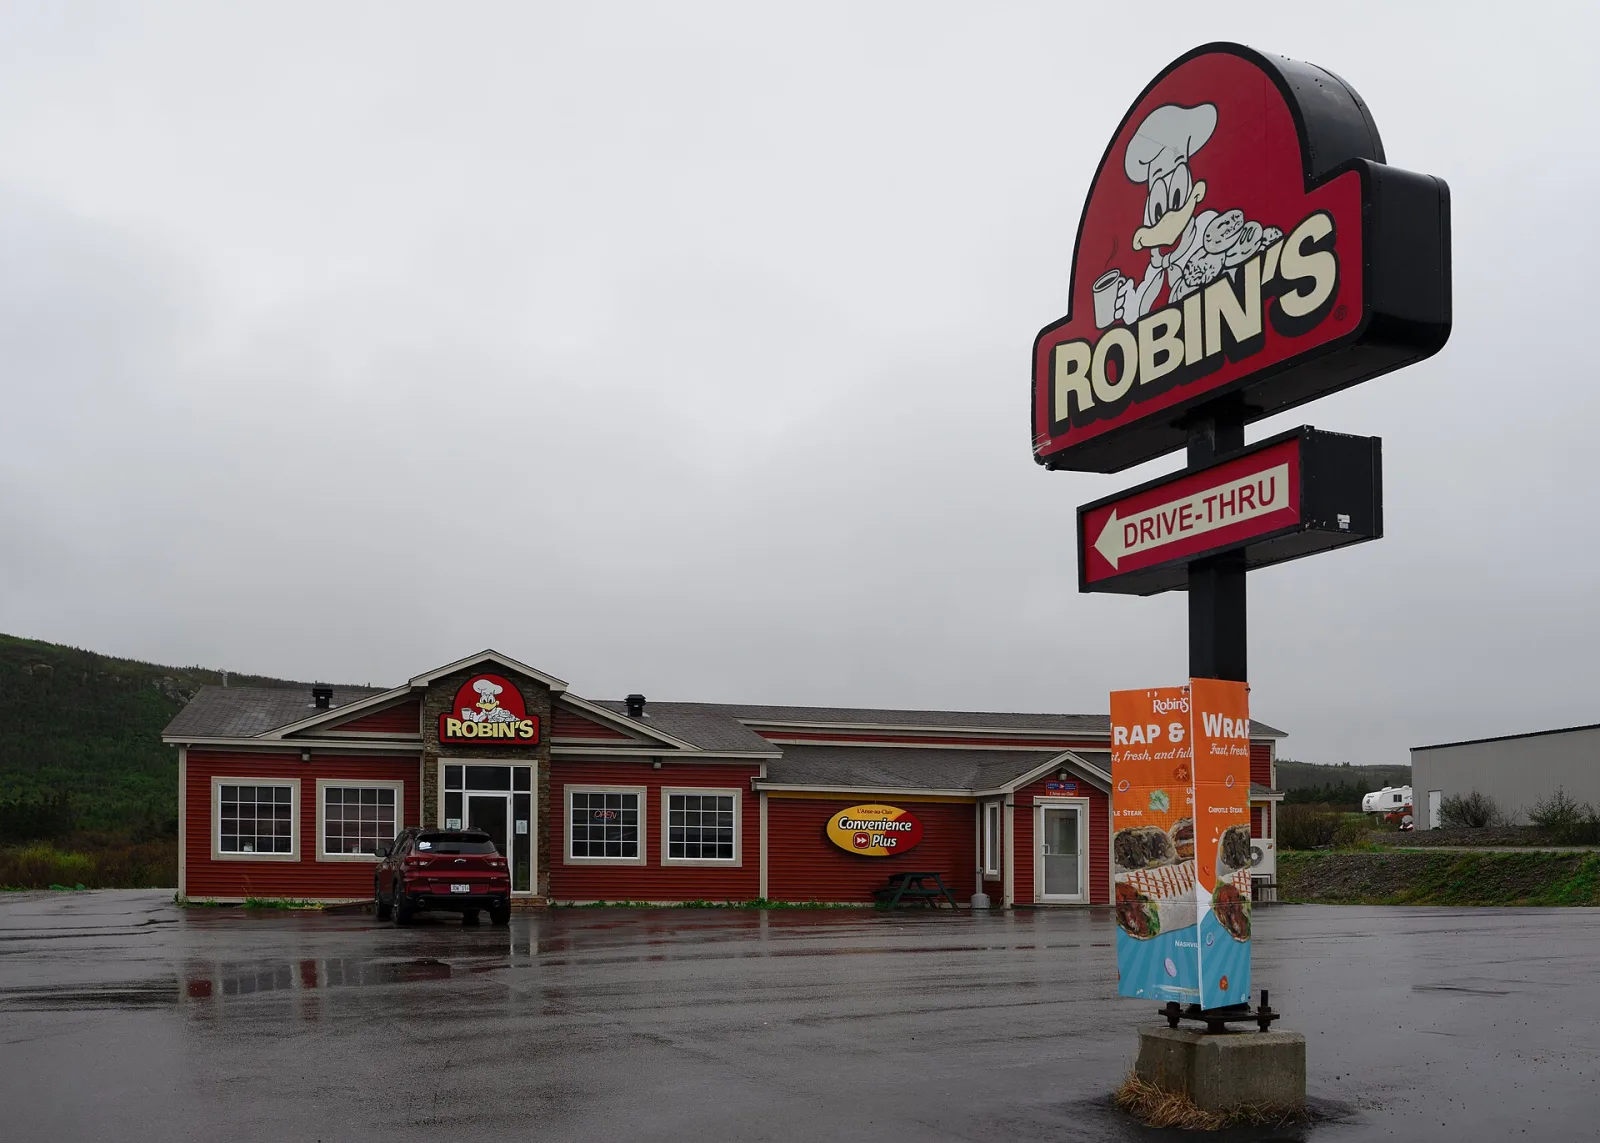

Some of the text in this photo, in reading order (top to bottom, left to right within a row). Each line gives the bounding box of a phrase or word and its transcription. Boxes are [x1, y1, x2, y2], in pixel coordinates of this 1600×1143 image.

[1054, 212, 1337, 424] ROBIN'S
[1123, 475, 1276, 550] DRIVE-THRU
[446, 717, 534, 738] ROBIN'S
[1110, 722, 1185, 745] RAP &
[1123, 749, 1152, 762] fresh,
[1154, 748, 1174, 760] and
[1123, 809, 1143, 817] STEAK
[838, 817, 912, 831] Convenience
[871, 834, 897, 847] Plus
